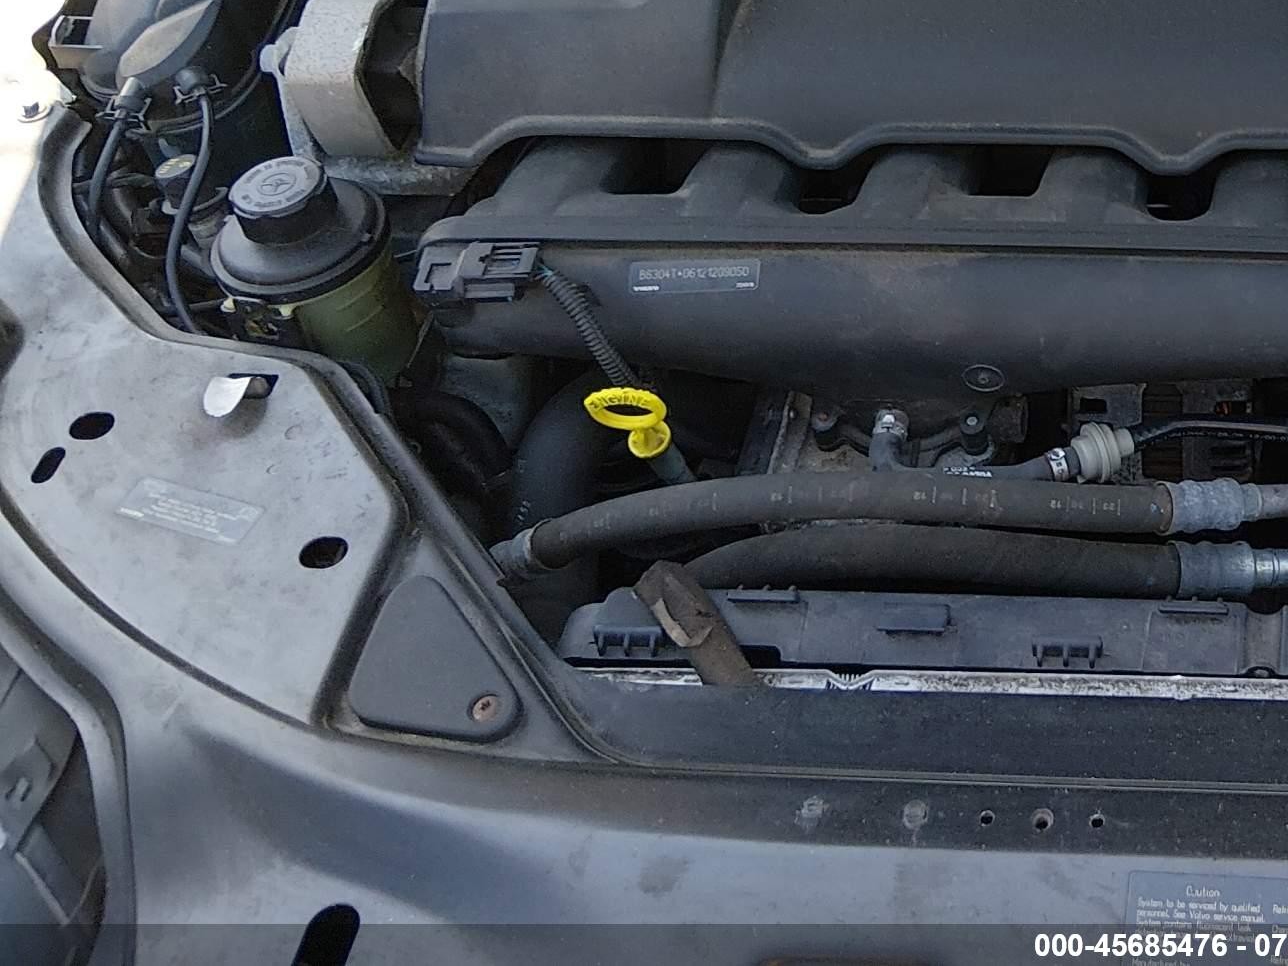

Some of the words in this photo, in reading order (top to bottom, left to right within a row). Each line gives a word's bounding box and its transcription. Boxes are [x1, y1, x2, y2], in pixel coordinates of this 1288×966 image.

[588, 393, 651, 411] ENGINE
[1186, 885, 1220, 897] Caution
[1166, 898, 1174, 908] to
[1177, 899, 1186, 908] be
[1188, 901, 1217, 910] serviced
[1219, 902, 1229, 912] by
[1231, 902, 1261, 913] qualified
[1174, 910, 1186, 919] See
[1189, 910, 1211, 921] Volvo
[1213, 913, 1238, 922] service
